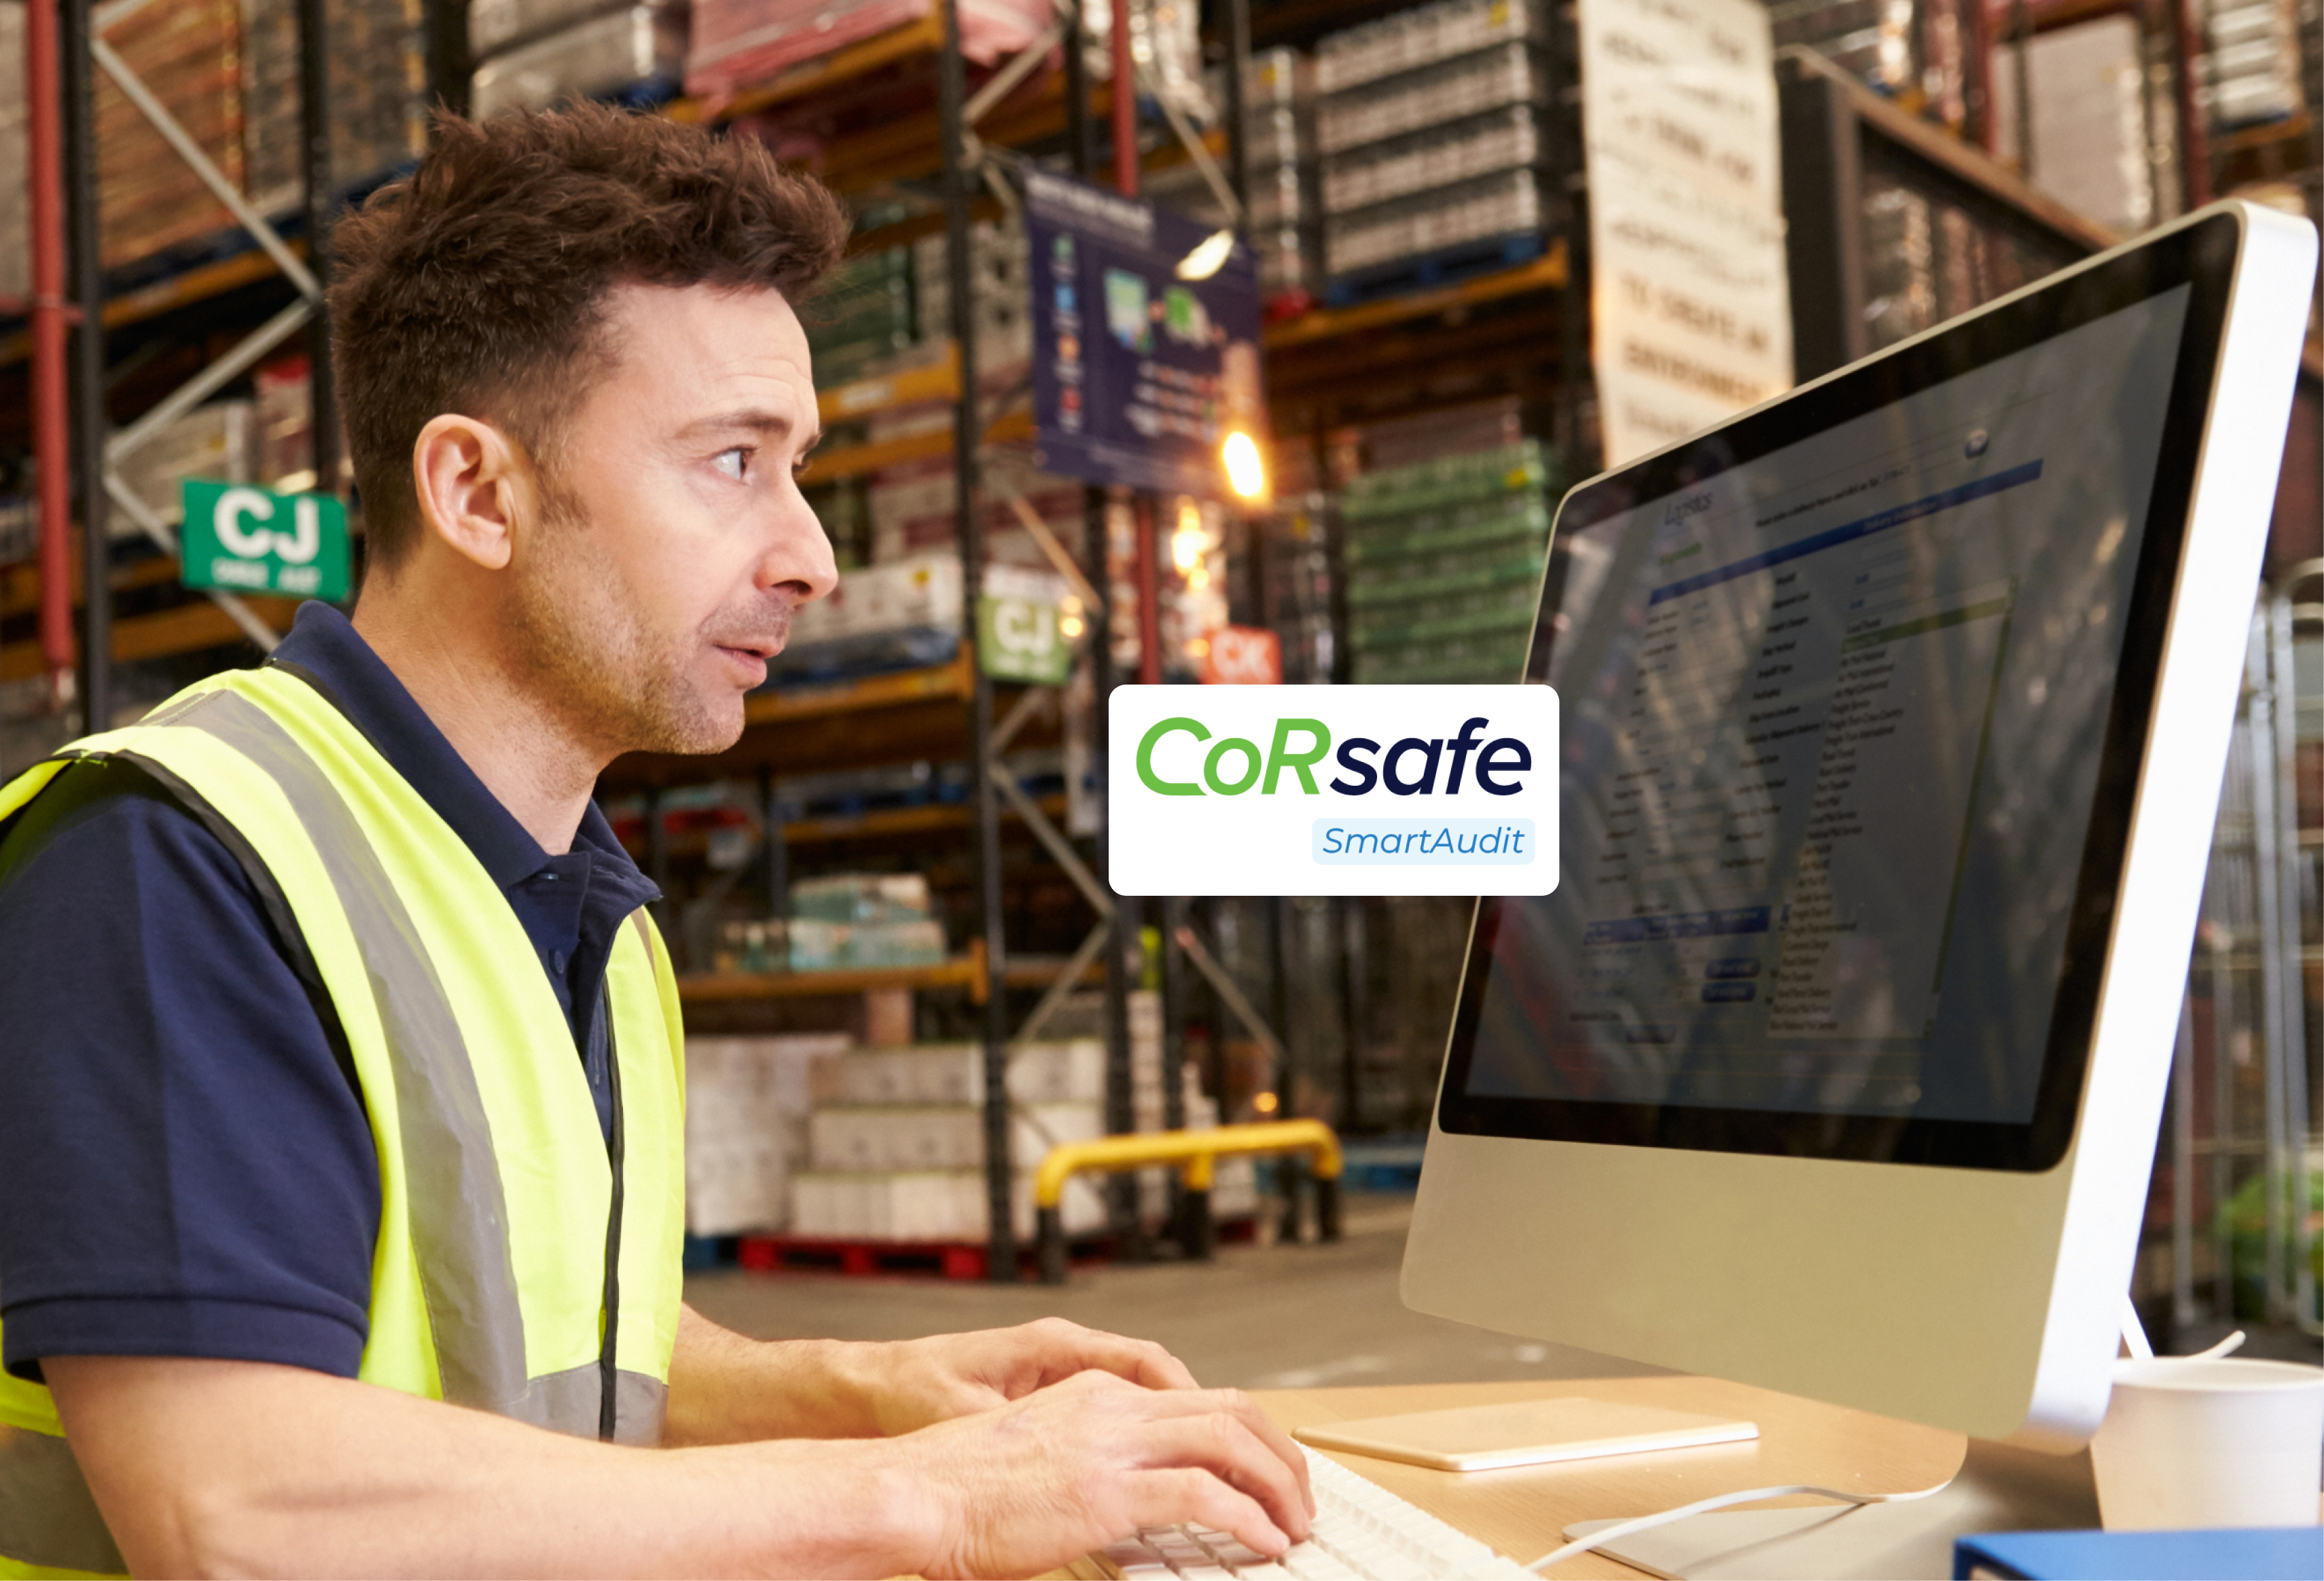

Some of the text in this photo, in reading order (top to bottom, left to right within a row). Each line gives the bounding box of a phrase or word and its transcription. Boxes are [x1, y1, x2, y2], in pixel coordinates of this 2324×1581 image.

[213, 486, 319, 564] CJ
[995, 601, 1058, 656] CJ
[1211, 632, 1274, 676] CK
